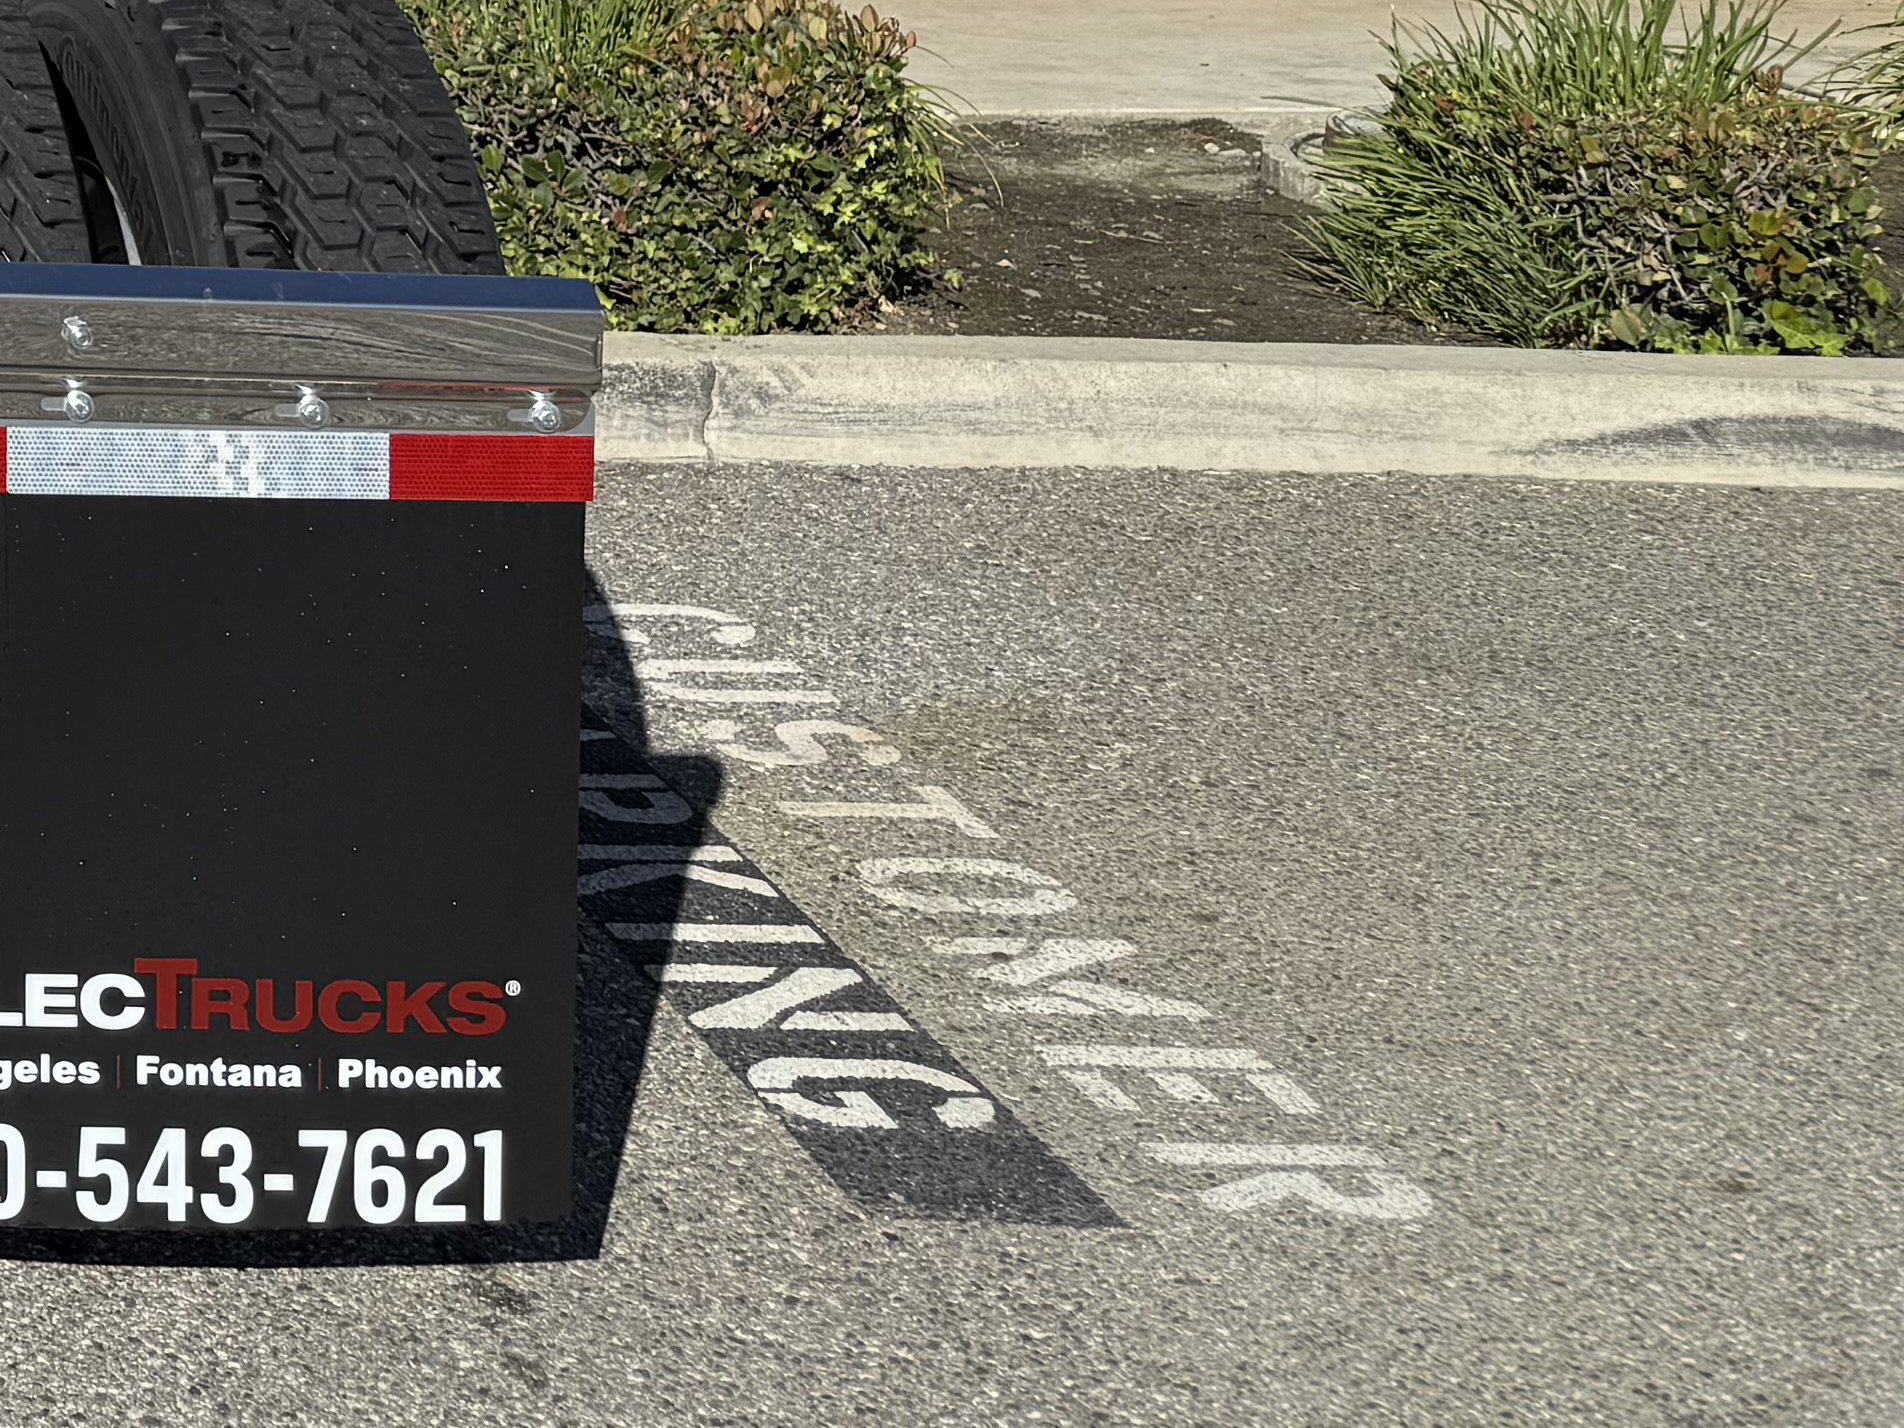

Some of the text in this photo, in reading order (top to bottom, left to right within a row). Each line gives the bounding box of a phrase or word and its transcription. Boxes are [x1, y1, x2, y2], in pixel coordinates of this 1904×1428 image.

[136, 1054, 303, 1088] Fontana
[338, 1058, 503, 1090] Phoenix
[577, 728, 998, 1130] RKING
[582, 602, 1434, 1222] CUSTOMER
